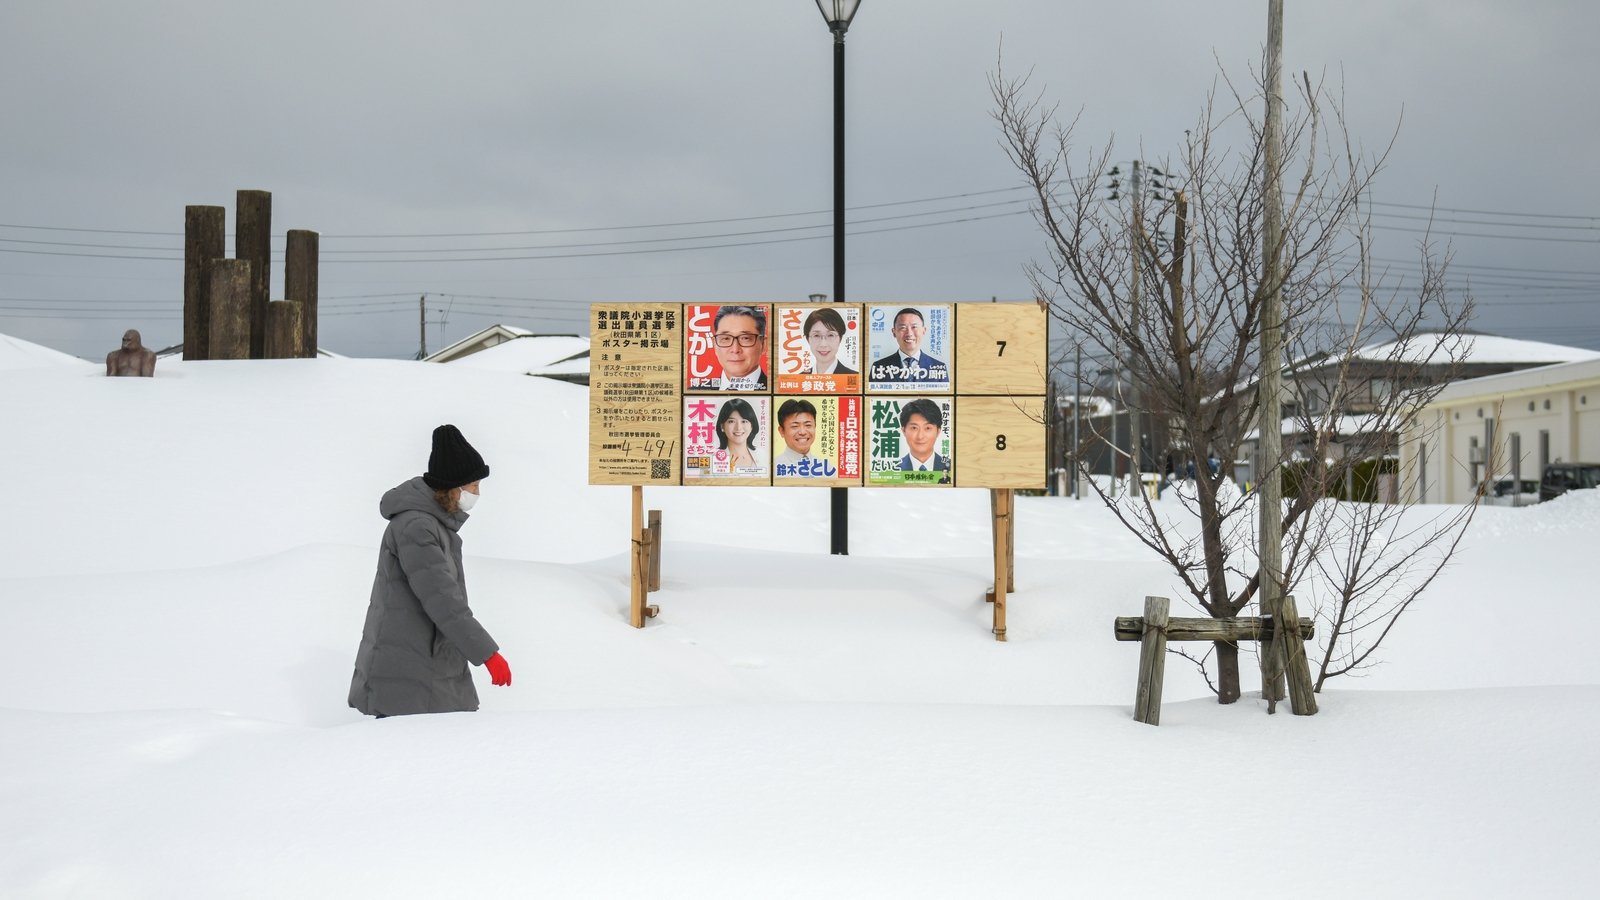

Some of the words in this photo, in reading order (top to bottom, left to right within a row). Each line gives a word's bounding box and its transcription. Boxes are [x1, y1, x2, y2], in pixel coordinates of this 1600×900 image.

[598, 311, 675, 320] 衆議院小選挙区
[598, 321, 675, 330] 選出議員選挙
[602, 340, 669, 348] ポスター掲示場
[689, 306, 714, 377] とがし
[783, 309, 802, 373] さとう
[996, 341, 1006, 357] 7
[872, 365, 928, 380] はやかわ
[690, 378, 711, 387] 博之
[802, 381, 836, 391] 参政党
[688, 400, 716, 444] 木村
[872, 401, 900, 458] 松浦
[846, 399, 858, 474] 比例は日本共産党
[996, 434, 1006, 450] 8
[622, 440, 675, 457] 4-491
[687, 445, 714, 454] さちこ
[777, 459, 836, 476] 鈴木さとし
[872, 460, 900, 471] だいご
